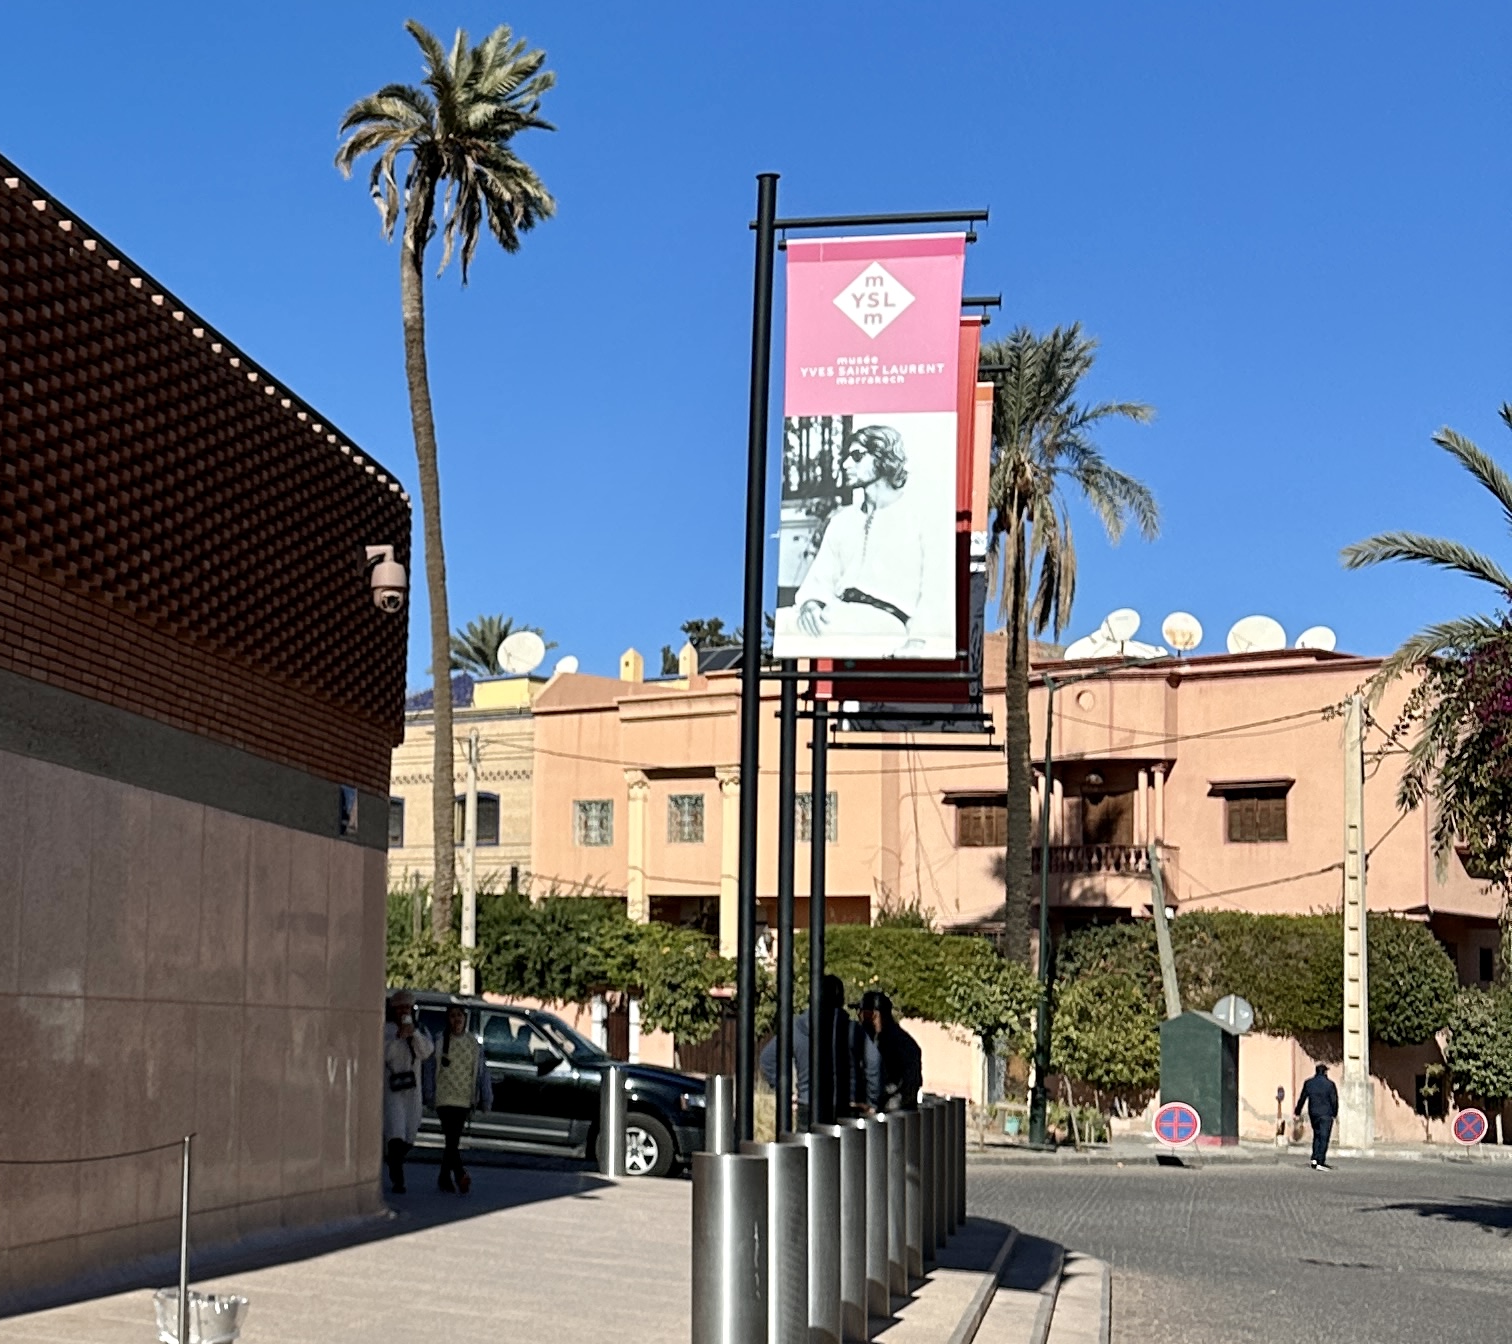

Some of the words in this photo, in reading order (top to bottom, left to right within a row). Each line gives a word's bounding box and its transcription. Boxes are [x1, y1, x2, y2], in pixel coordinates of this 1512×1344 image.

[865, 275, 883, 287] m
[852, 292, 896, 308] YSL
[864, 313, 882, 325] m
[800, 367, 834, 377] YVES
[839, 365, 879, 376] SAINT
[883, 363, 944, 374] LAURENT
